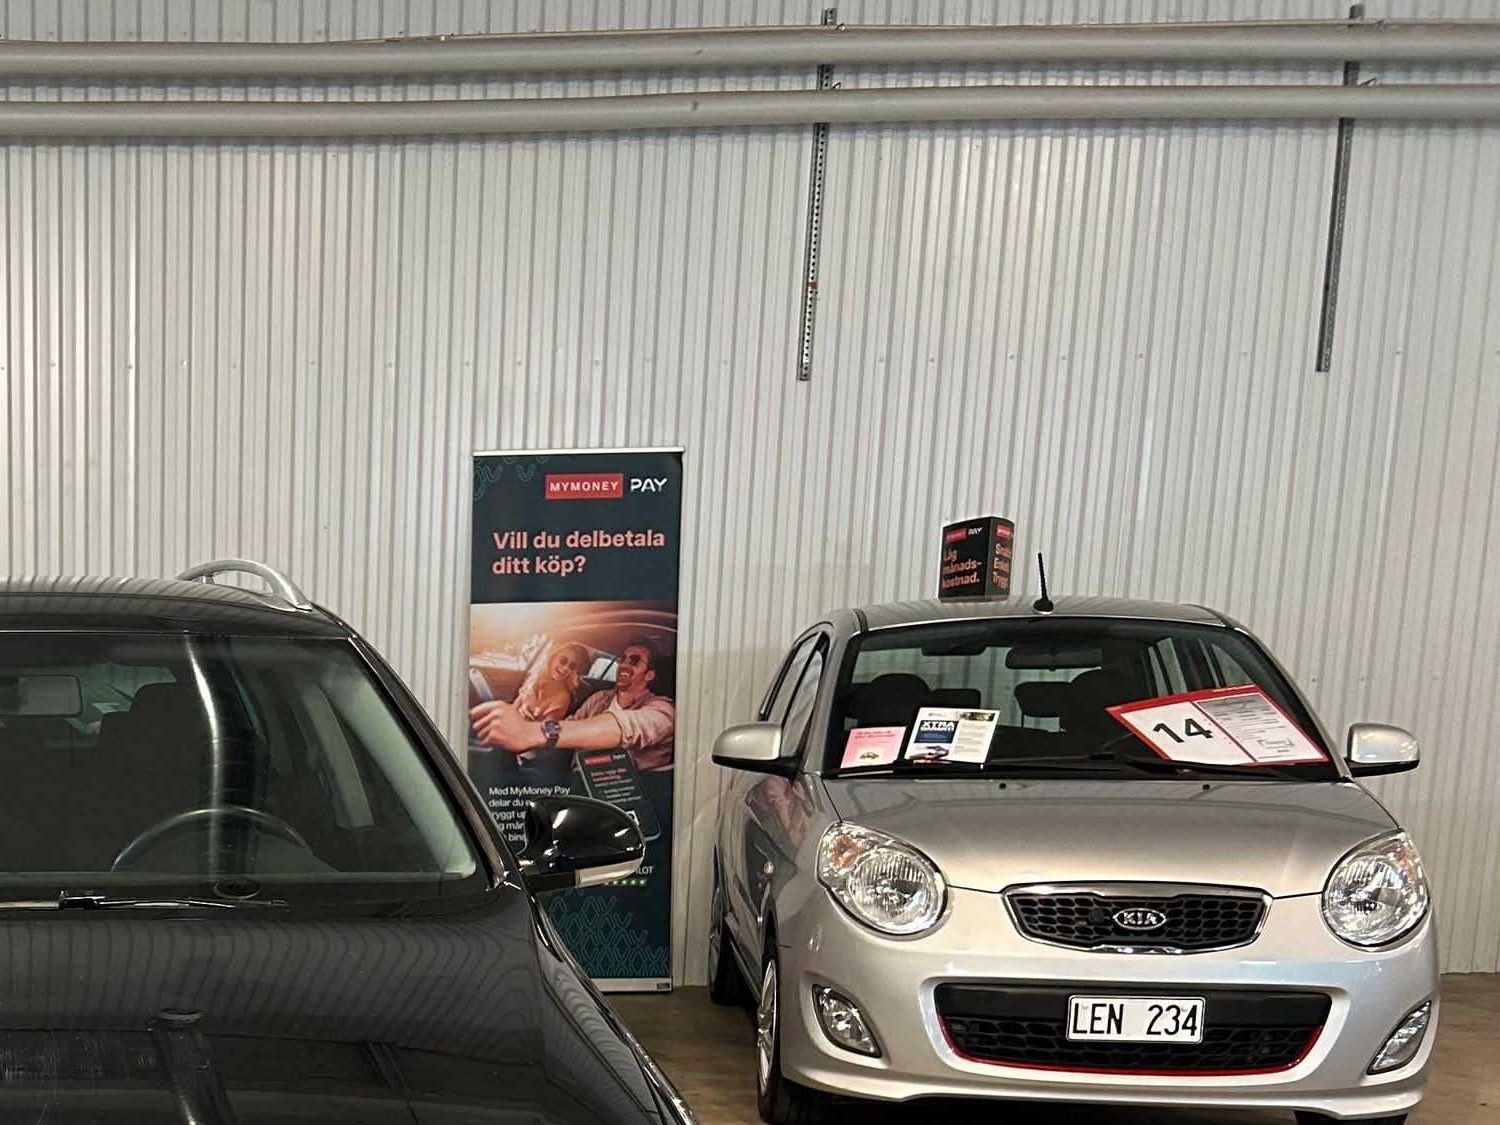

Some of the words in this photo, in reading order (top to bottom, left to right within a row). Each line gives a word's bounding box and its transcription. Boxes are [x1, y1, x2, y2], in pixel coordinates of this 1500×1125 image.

[549, 481, 619, 493] MYMONEY
[630, 478, 668, 493] PAY
[492, 532, 528, 550] Vill
[533, 531, 561, 550] du
[566, 529, 665, 549] delbetala
[492, 556, 530, 575] ditt
[535, 555, 586, 577] köp?
[942, 559, 982, 574] månads-
[942, 572, 980, 588] kostnad.
[1153, 718, 1213, 744] 14
[488, 786, 509, 796] Med
[509, 786, 553, 797] MyMoney
[554, 785, 571, 797] Pay
[488, 798, 511, 808] delar
[512, 799, 524, 807] du
[491, 810, 515, 821] ryggt
[1122, 911, 1158, 925] KIA
[1072, 1002, 1124, 1035] LEN
[1146, 1004, 1198, 1037] 234
